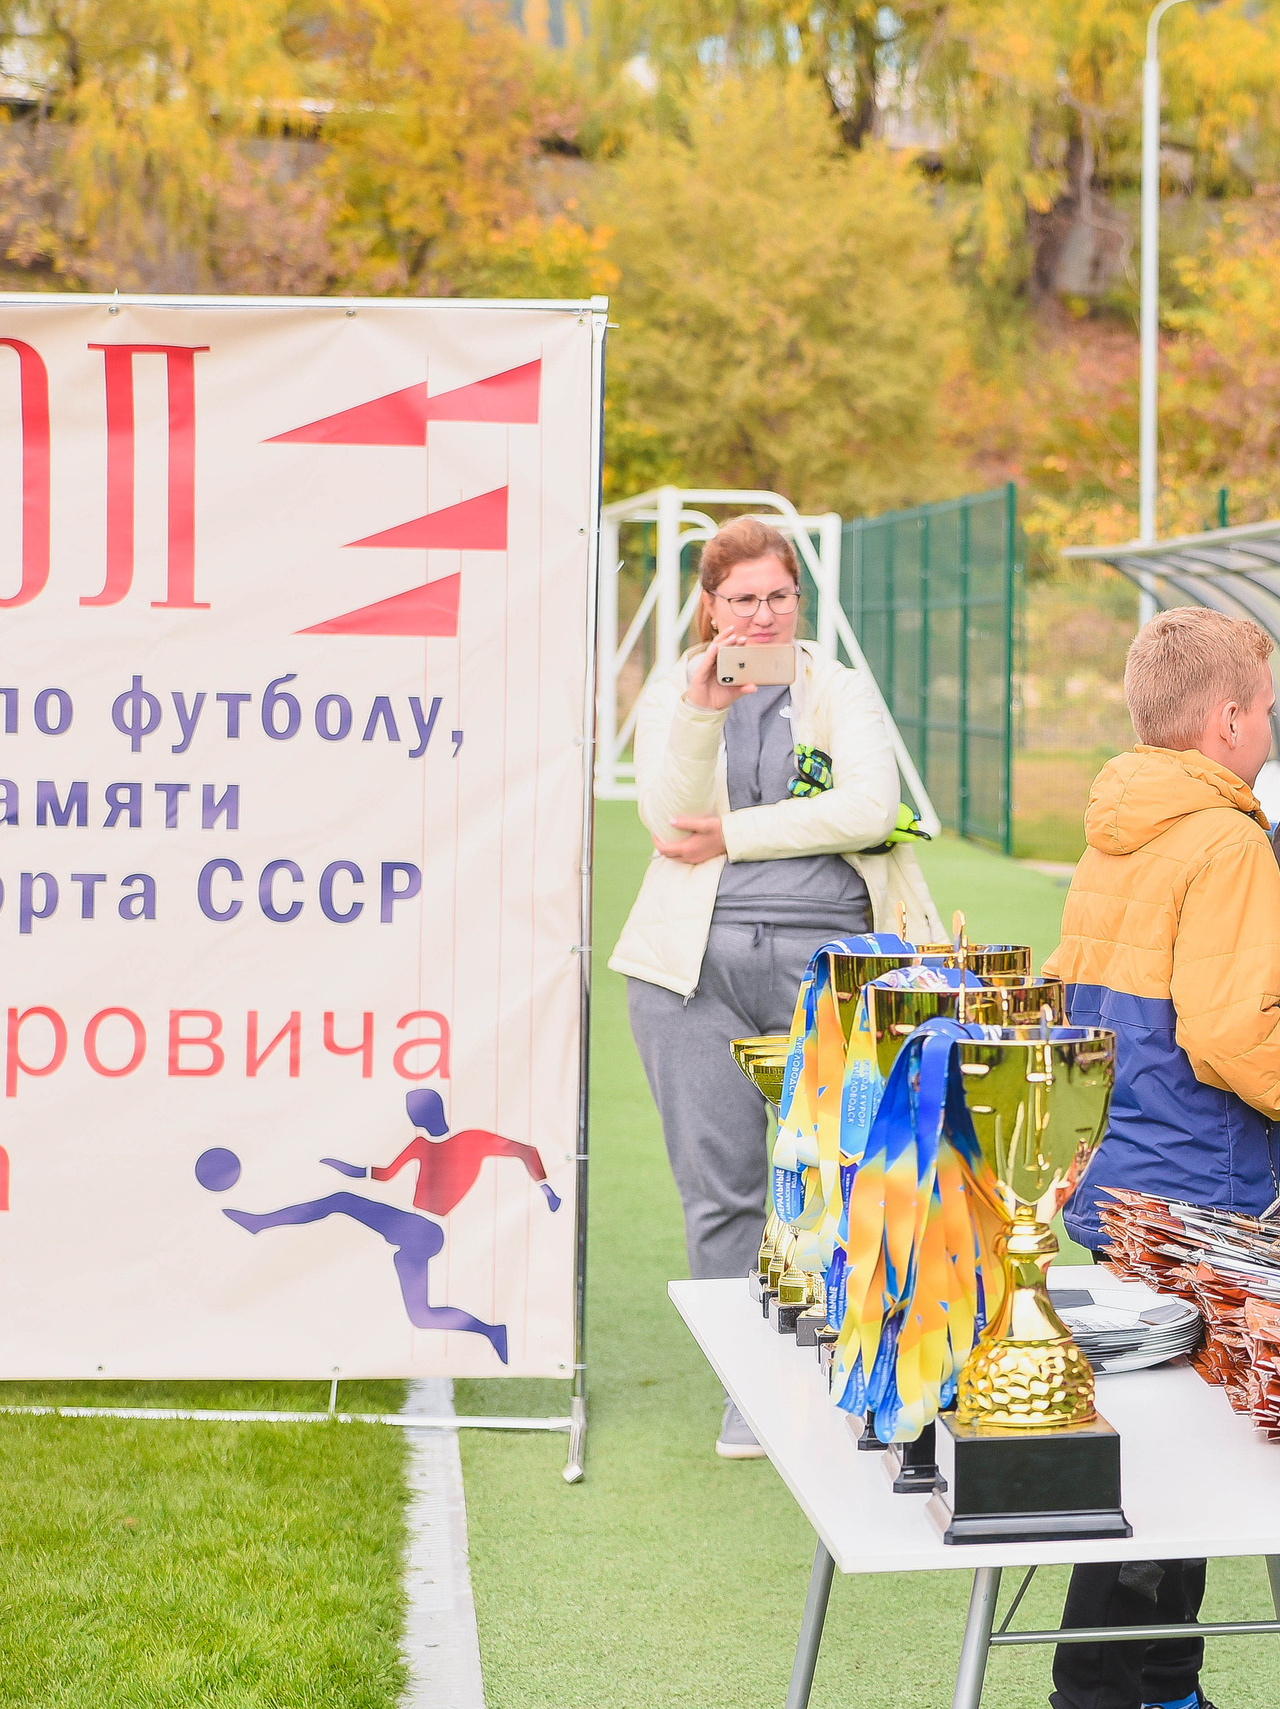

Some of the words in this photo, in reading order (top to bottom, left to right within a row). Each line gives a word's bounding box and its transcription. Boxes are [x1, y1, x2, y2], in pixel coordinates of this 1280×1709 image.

[111, 673, 464, 759] футболу,
[0, 871, 157, 934] рта
[199, 858, 423, 924] СССР
[5, 1004, 453, 1098] ровича
